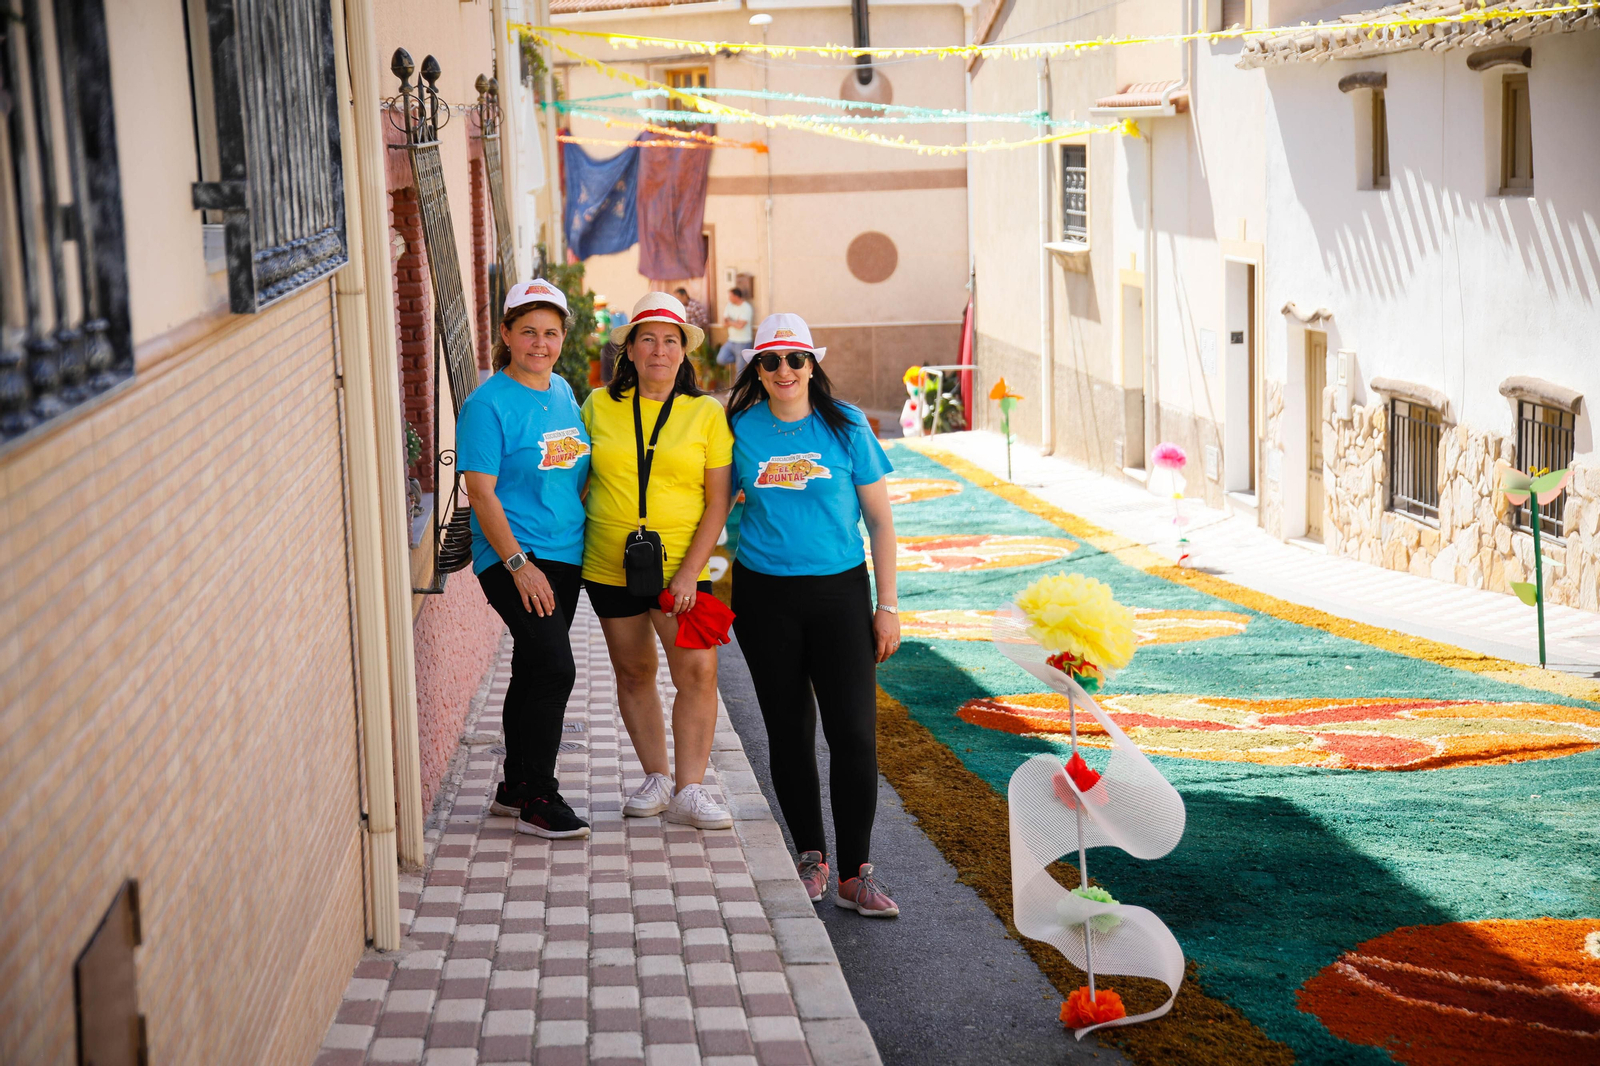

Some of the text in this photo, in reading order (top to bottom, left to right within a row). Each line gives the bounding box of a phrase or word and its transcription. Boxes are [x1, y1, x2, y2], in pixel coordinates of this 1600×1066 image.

[556, 445, 564, 453] EL
[551, 452, 576, 463] PUNTAL
[768, 473, 805, 483] PUNTAL
